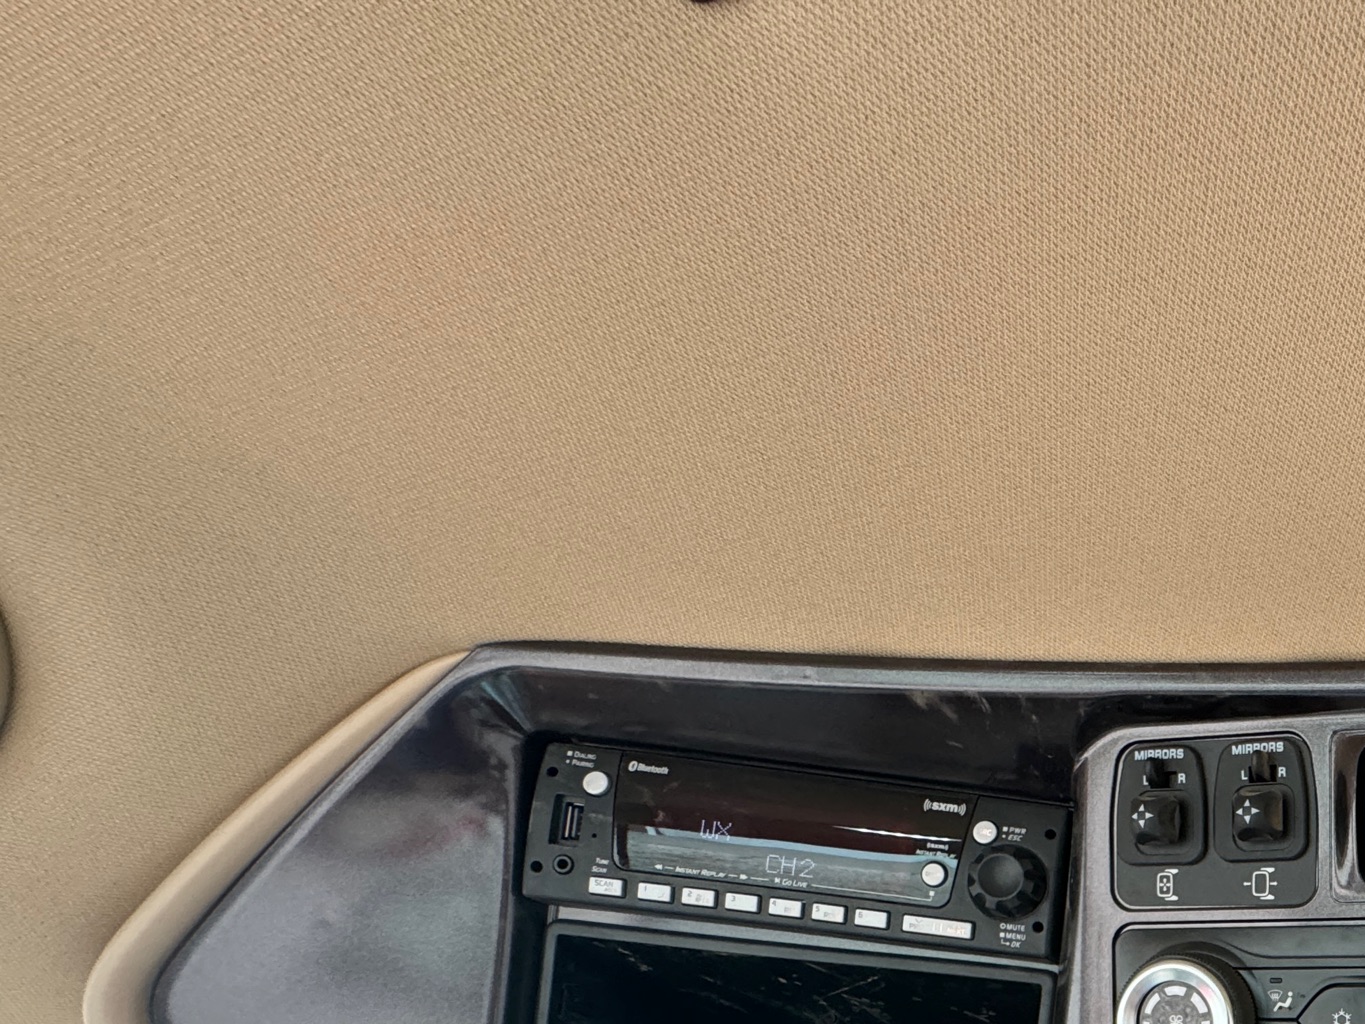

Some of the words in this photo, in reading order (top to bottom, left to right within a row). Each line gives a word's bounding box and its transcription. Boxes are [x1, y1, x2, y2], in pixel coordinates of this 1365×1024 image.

[1232, 742, 1284, 755] MIRRORS
[1134, 749, 1184, 761] MIRRORS
[637, 763, 669, 775] Bluetooth
[1241, 770, 1248, 780] L
[1278, 767, 1286, 777] R
[1143, 775, 1149, 785] L
[1178, 773, 1186, 783] R
[700, 819, 732, 841] WX
[1009, 826, 1027, 834] PWR
[1008, 834, 1023, 842] ESC
[675, 866, 701, 876] INSTANT
[594, 879, 613, 888] SCAN
[1006, 924, 1025, 932] MUTE
[1006, 932, 1026, 941] MENU
